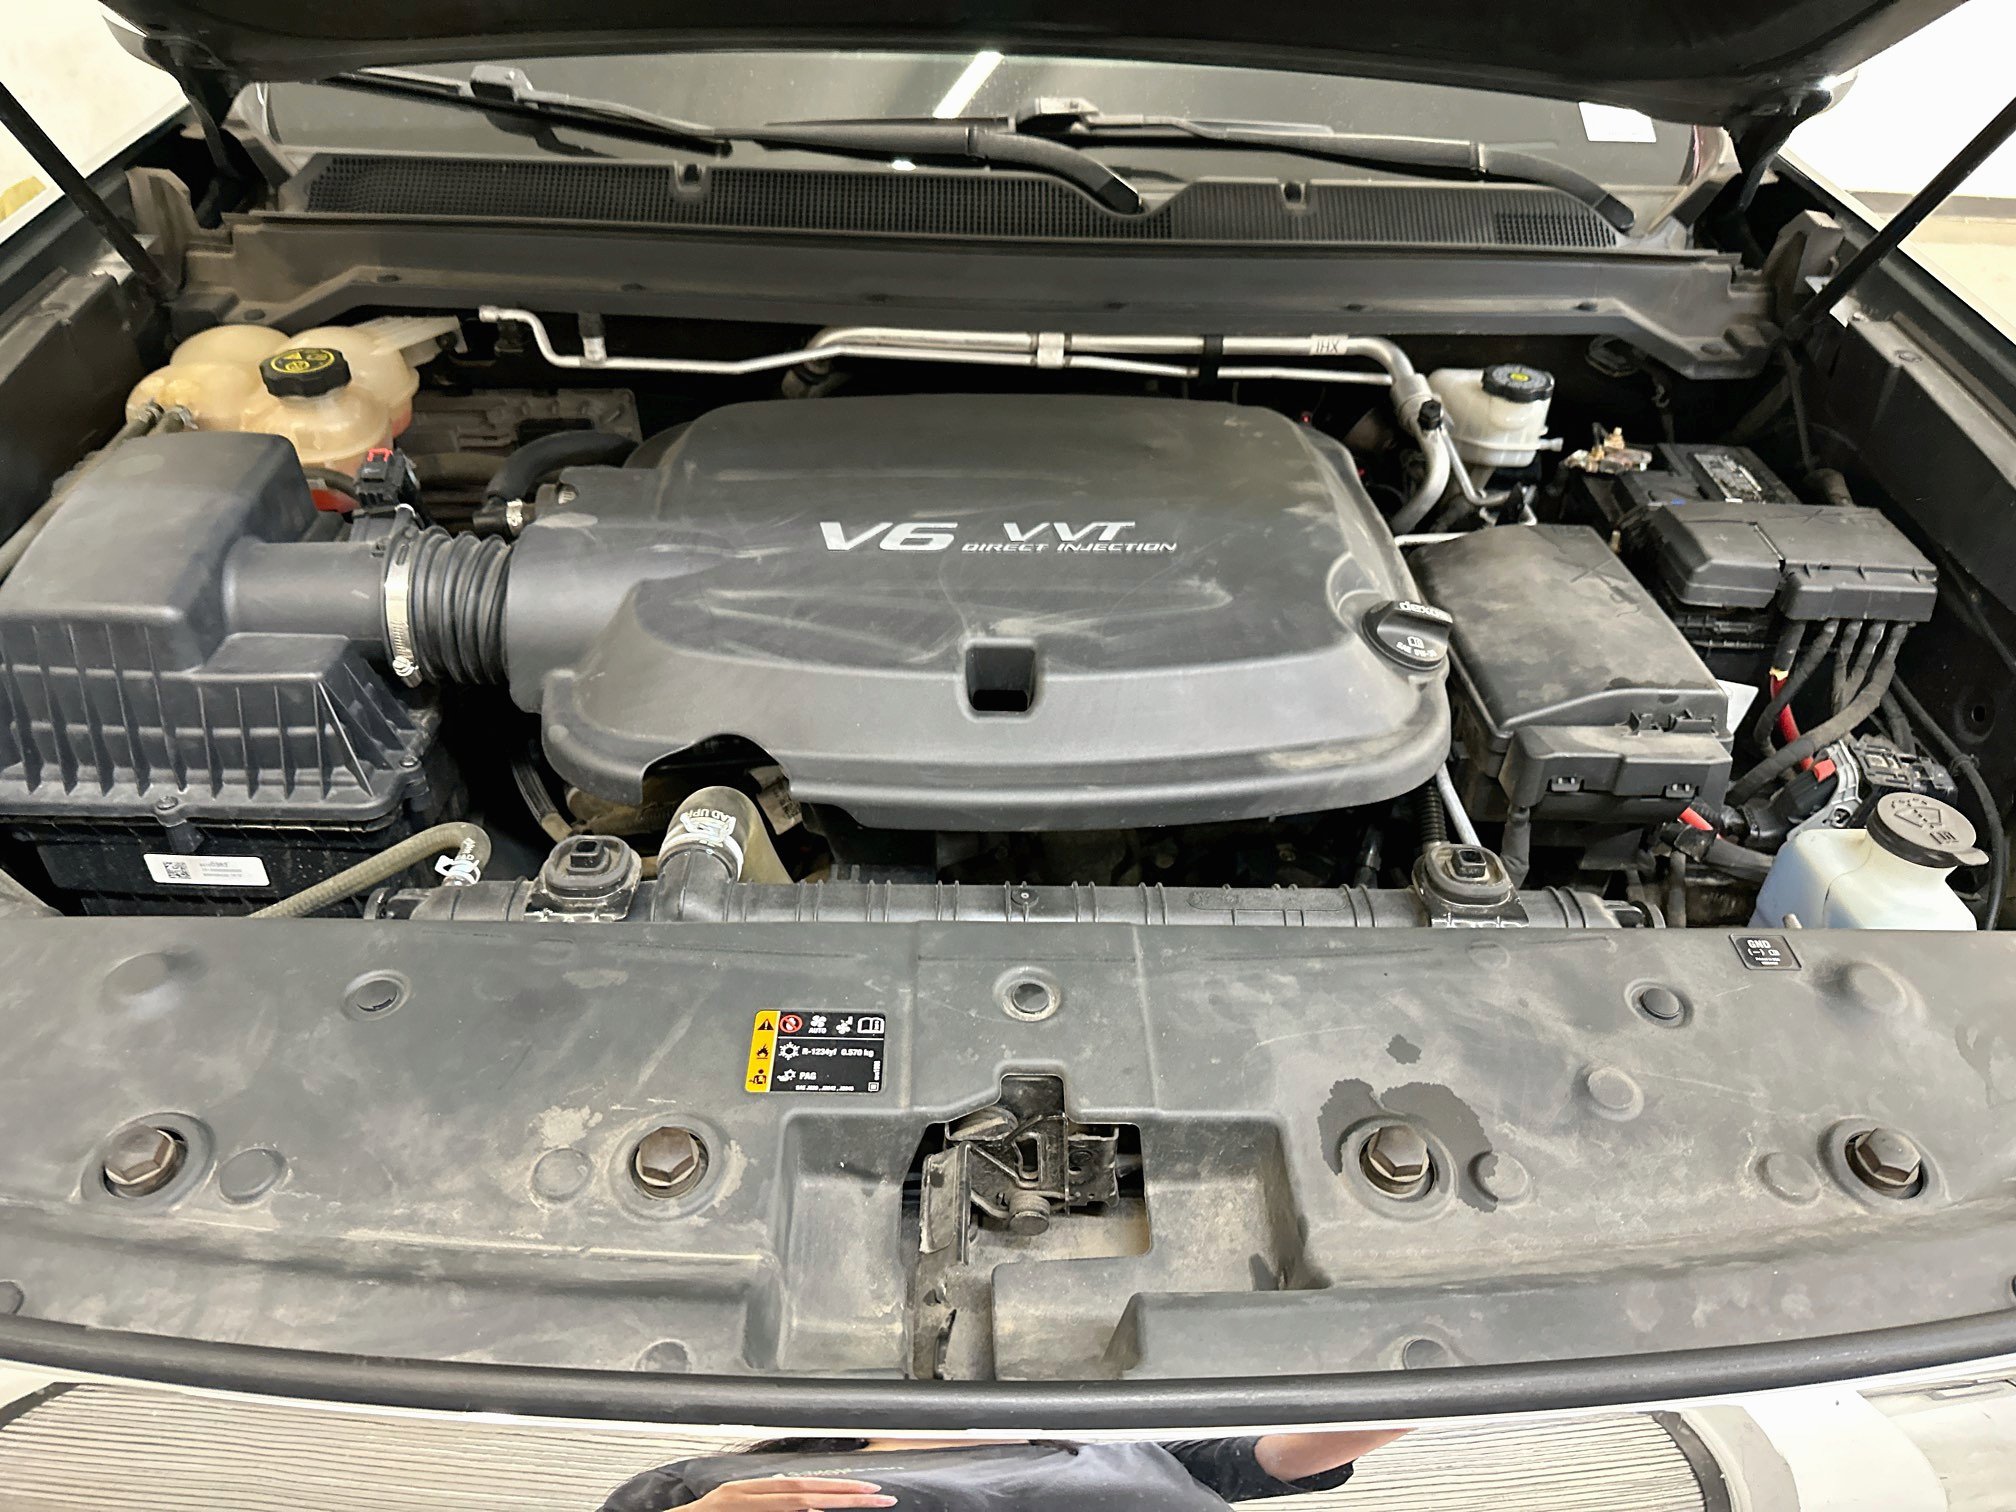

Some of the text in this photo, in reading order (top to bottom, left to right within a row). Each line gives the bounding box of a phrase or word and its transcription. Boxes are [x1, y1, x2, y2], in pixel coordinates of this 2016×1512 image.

[819, 521, 1136, 551] V6 VVT
[961, 542, 1177, 552] DIRECT INJECTION
[1747, 939, 1772, 949] GND
[801, 1048, 875, 1058] R-1234yf 0.570 kg
[799, 1071, 817, 1080] PAG
